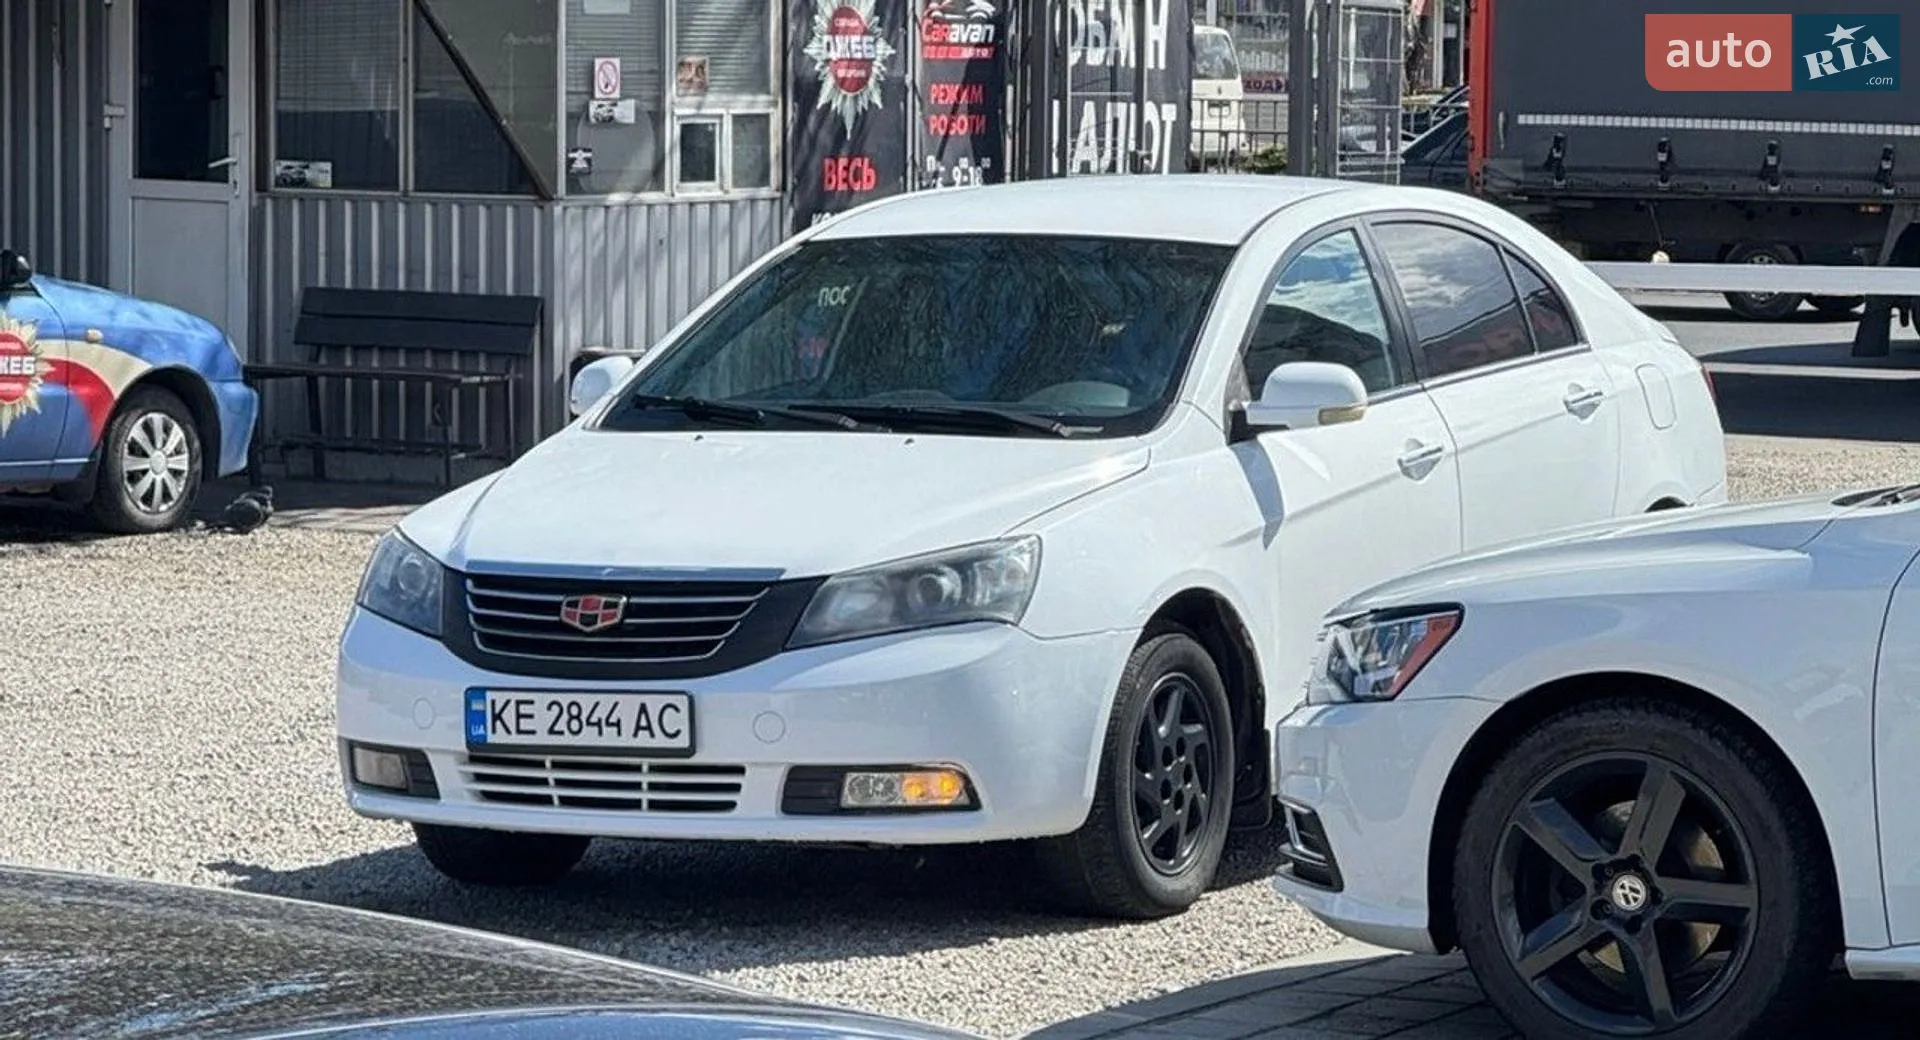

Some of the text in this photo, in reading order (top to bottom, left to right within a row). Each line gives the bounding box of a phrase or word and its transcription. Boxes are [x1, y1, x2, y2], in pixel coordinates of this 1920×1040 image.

[1054, 0, 1168, 69] ОБМН
[930, 84, 983, 105] РЕЖИМ
[928, 114, 986, 136] РОБОТИ
[823, 158, 876, 192] ВЕСЬ
[490, 699, 683, 739] KE 2844 AC
